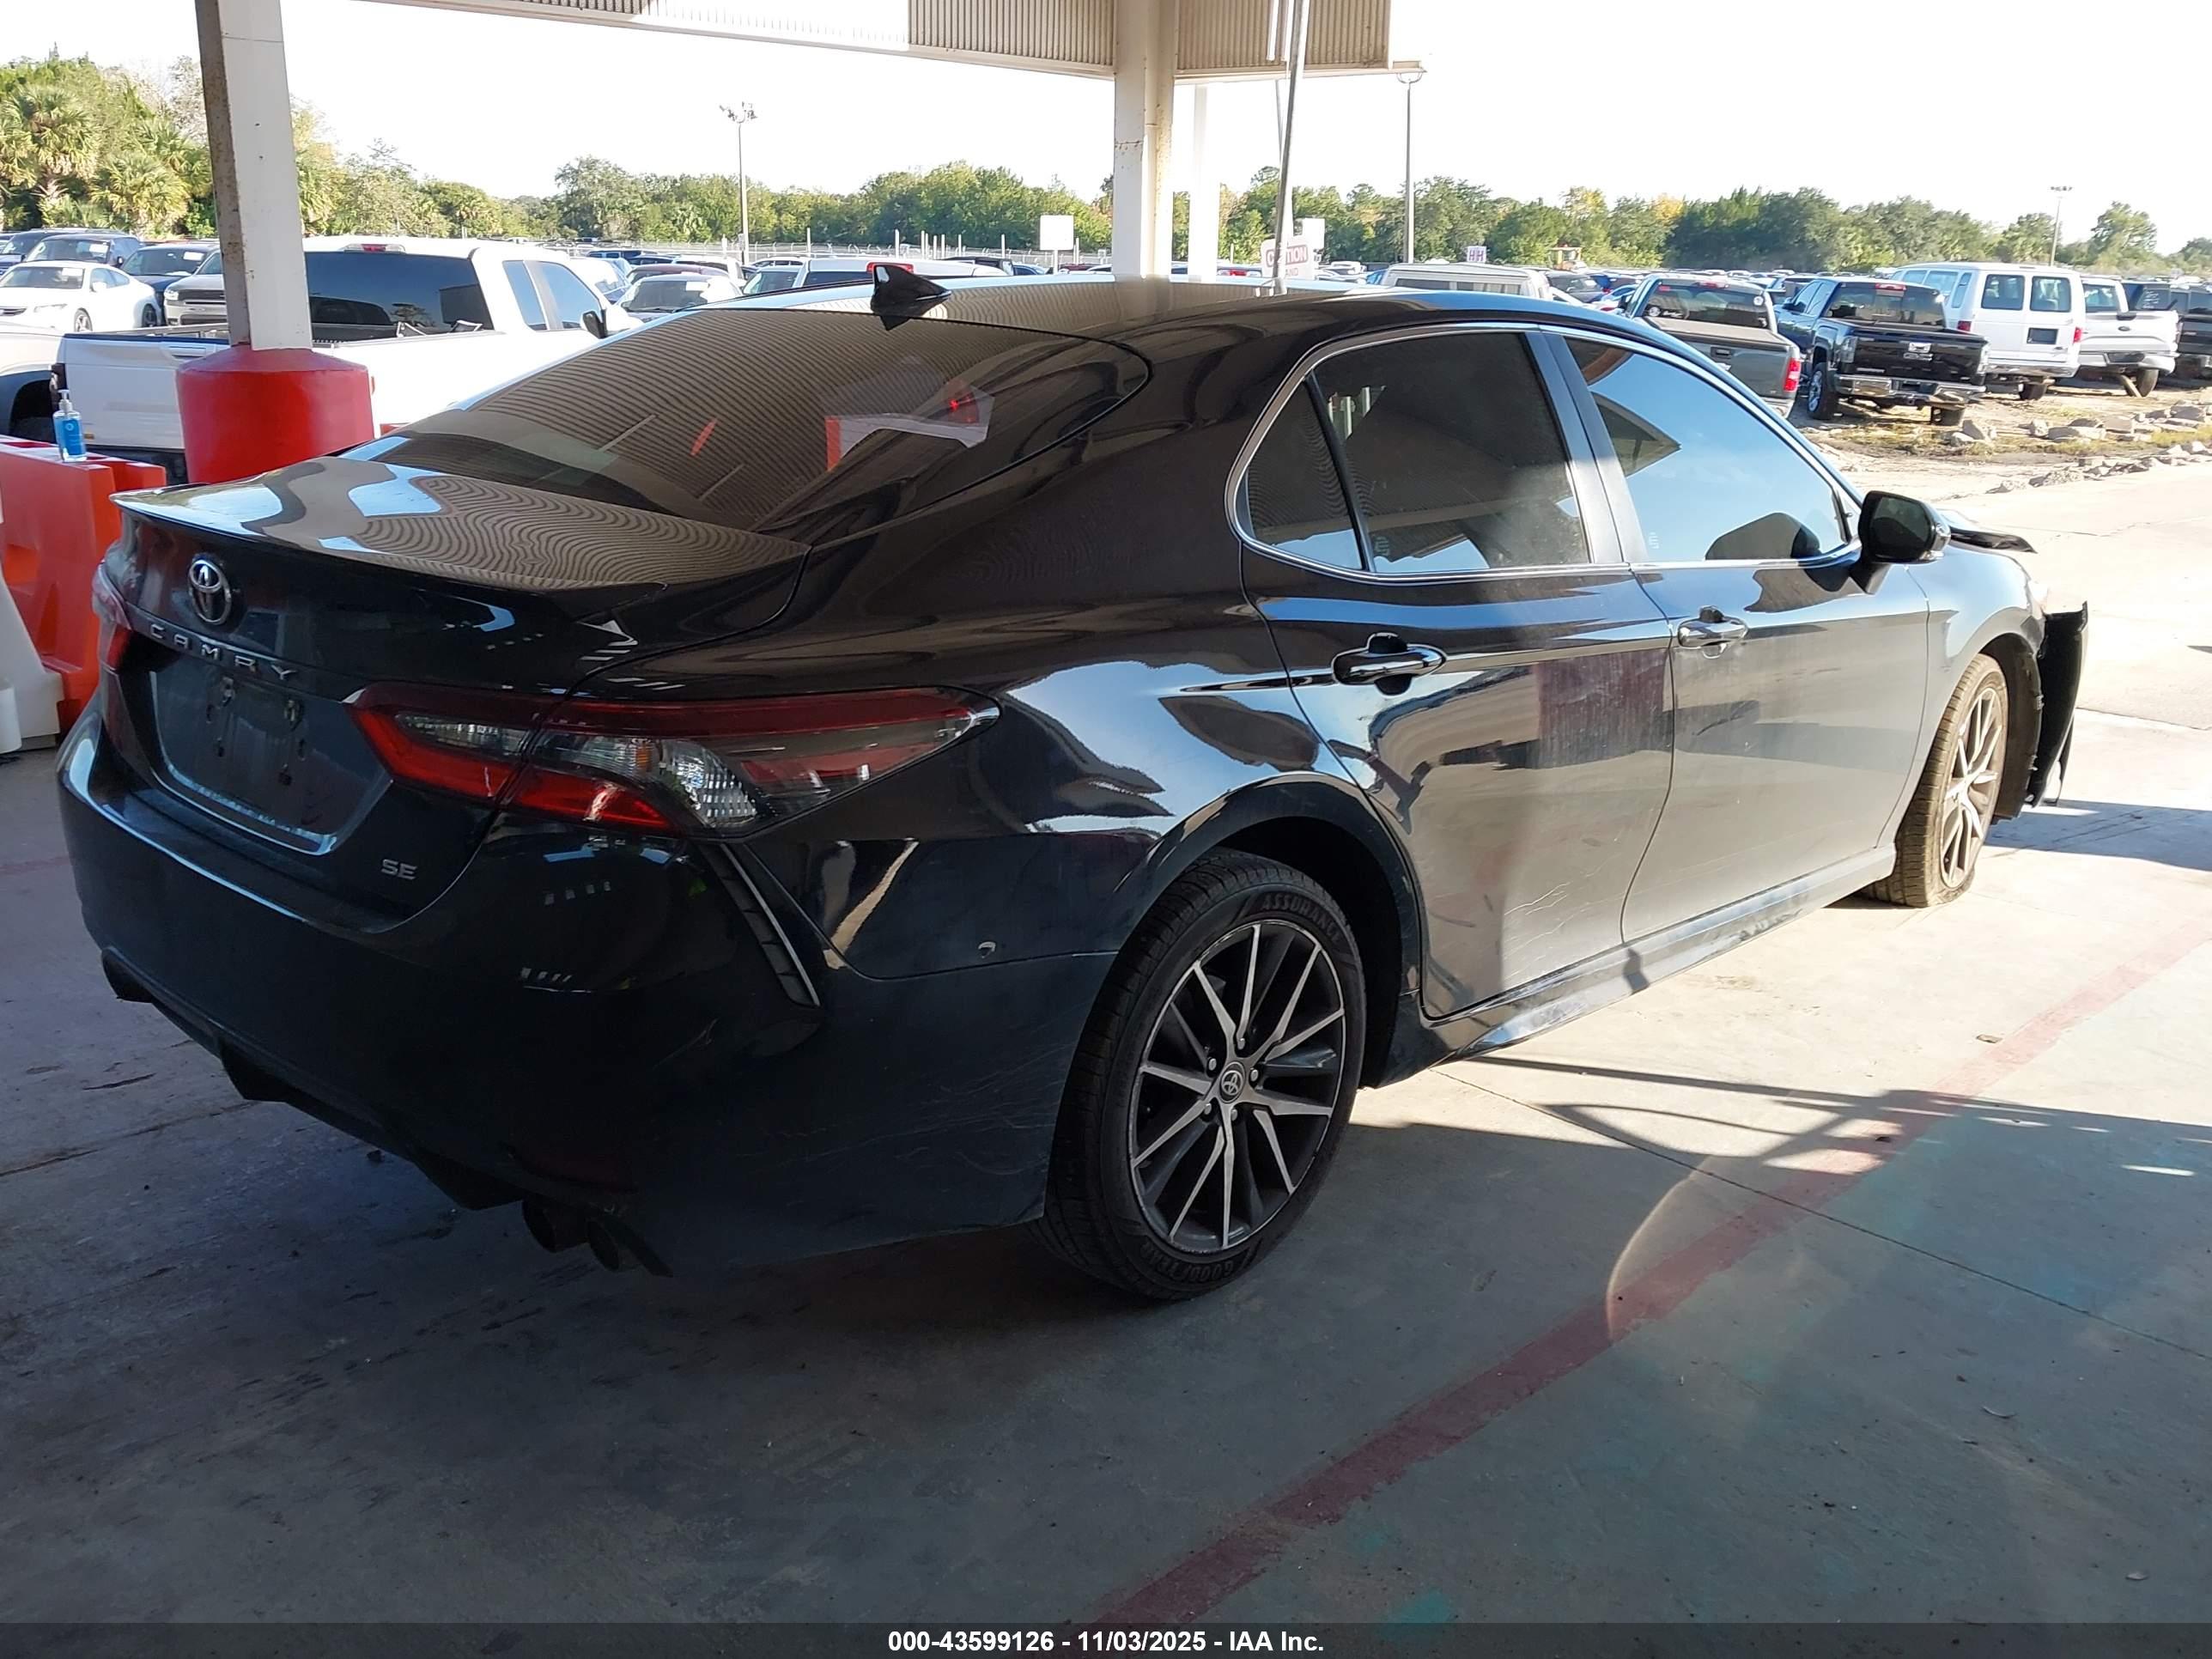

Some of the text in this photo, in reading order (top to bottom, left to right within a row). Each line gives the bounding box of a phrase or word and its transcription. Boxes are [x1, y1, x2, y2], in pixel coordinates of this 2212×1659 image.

[1267, 246, 1307, 266] CTION
[150, 623, 297, 680] CAMRY
[381, 859, 418, 880] SE
